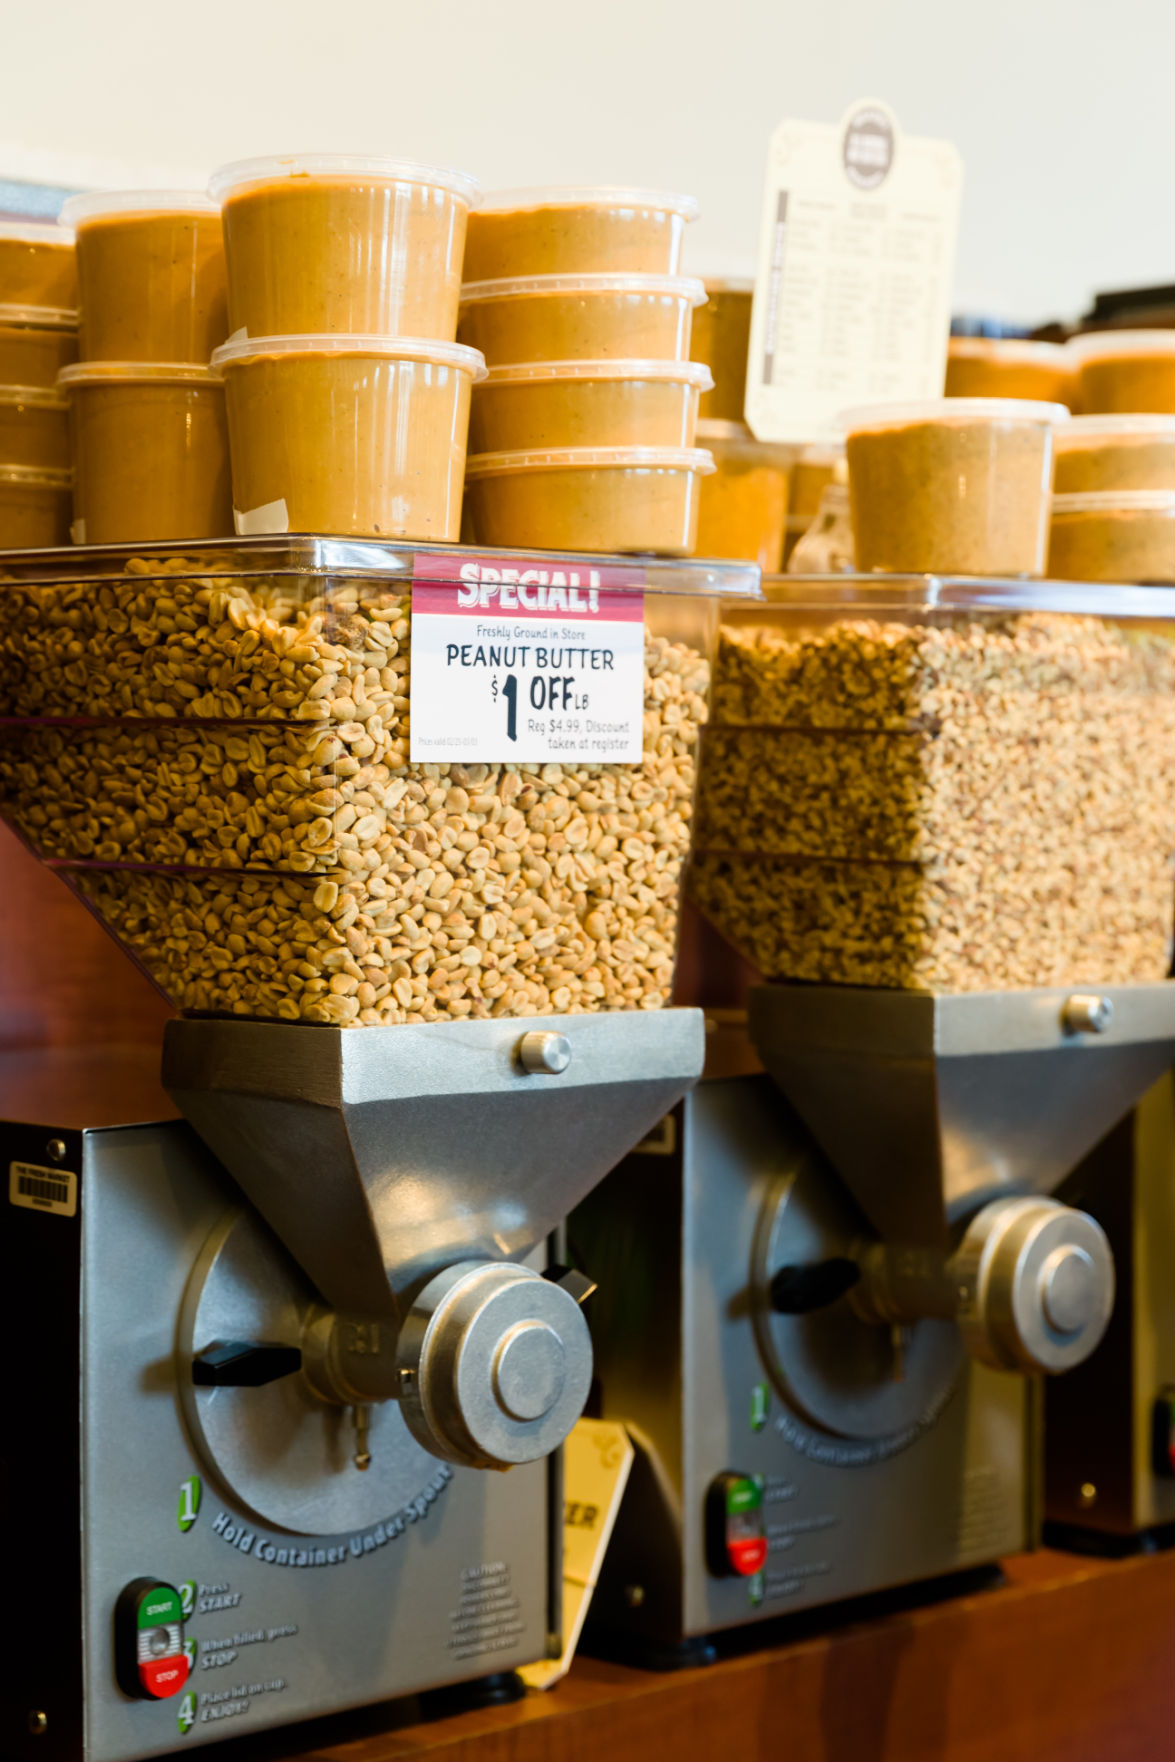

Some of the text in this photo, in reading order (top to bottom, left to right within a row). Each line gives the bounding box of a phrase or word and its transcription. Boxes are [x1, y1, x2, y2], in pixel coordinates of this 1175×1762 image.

[457, 562, 600, 613] SPECIAL!
[476, 624, 586, 641] Freshly Ground in Store
[446, 644, 615, 670] PEANUT BUTTER
[529, 675, 576, 711] OFF
[528, 719, 545, 735] Reg
[586, 720, 630, 733] Discount
[548, 737, 630, 754] taken at register
[179, 1481, 197, 1521] 1
[212, 1460, 454, 1568] Hold Container Under Spout
[146, 1601, 173, 1616] START
[178, 1583, 194, 1614] 2
[199, 1594, 242, 1613] START
[200, 1650, 239, 1670] STOP
[155, 1669, 179, 1683] STOP
[178, 1694, 195, 1726] 4
